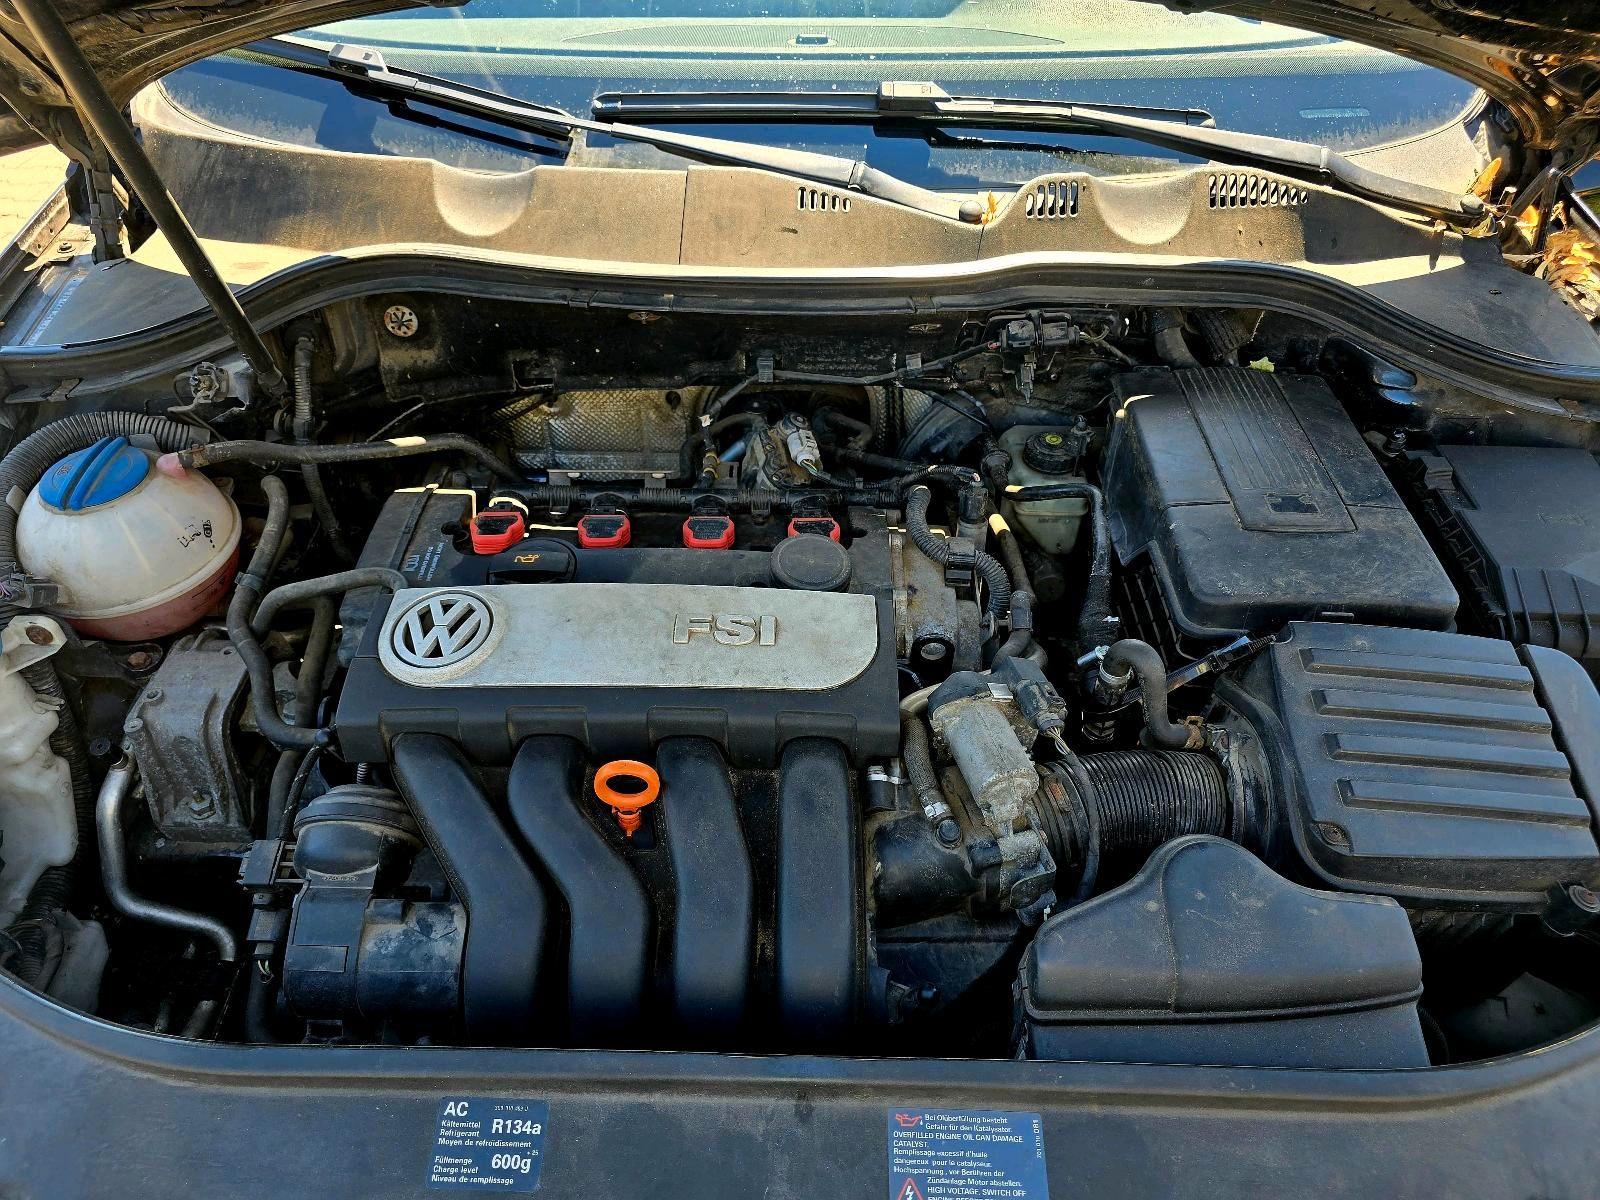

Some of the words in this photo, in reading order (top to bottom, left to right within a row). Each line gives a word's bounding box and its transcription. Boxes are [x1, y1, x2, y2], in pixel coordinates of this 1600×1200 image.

[672, 612, 780, 647] FSI
[443, 1101, 469, 1117] AC
[924, 1113, 936, 1121] Bei
[491, 1118, 542, 1135] R134a
[439, 1128, 480, 1138] Refrigerant
[893, 1131, 934, 1139] OVERFILLED
[935, 1132, 962, 1140] ENGINE
[962, 1133, 975, 1141] OIL
[992, 1135, 1024, 1143] DAMAGE
[438, 1137, 463, 1146] Moyen
[464, 1138, 474, 1146] de
[893, 1147, 936, 1158] Remplissage
[434, 1155, 473, 1165] Füllmenge
[491, 1153, 532, 1174] 600g
[932, 1159, 948, 1167] pour
[433, 1165, 459, 1175] Charge
[461, 1166, 479, 1174] level
[431, 1174, 457, 1183] Niveau
[459, 1175, 469, 1183] de
[470, 1176, 514, 1186] remplissage
[967, 1178, 989, 1186] Motor
[927, 1186, 946, 1194] HIGH
[982, 1188, 1011, 1197] SWITCH
[1012, 1189, 1027, 1197] OFF
